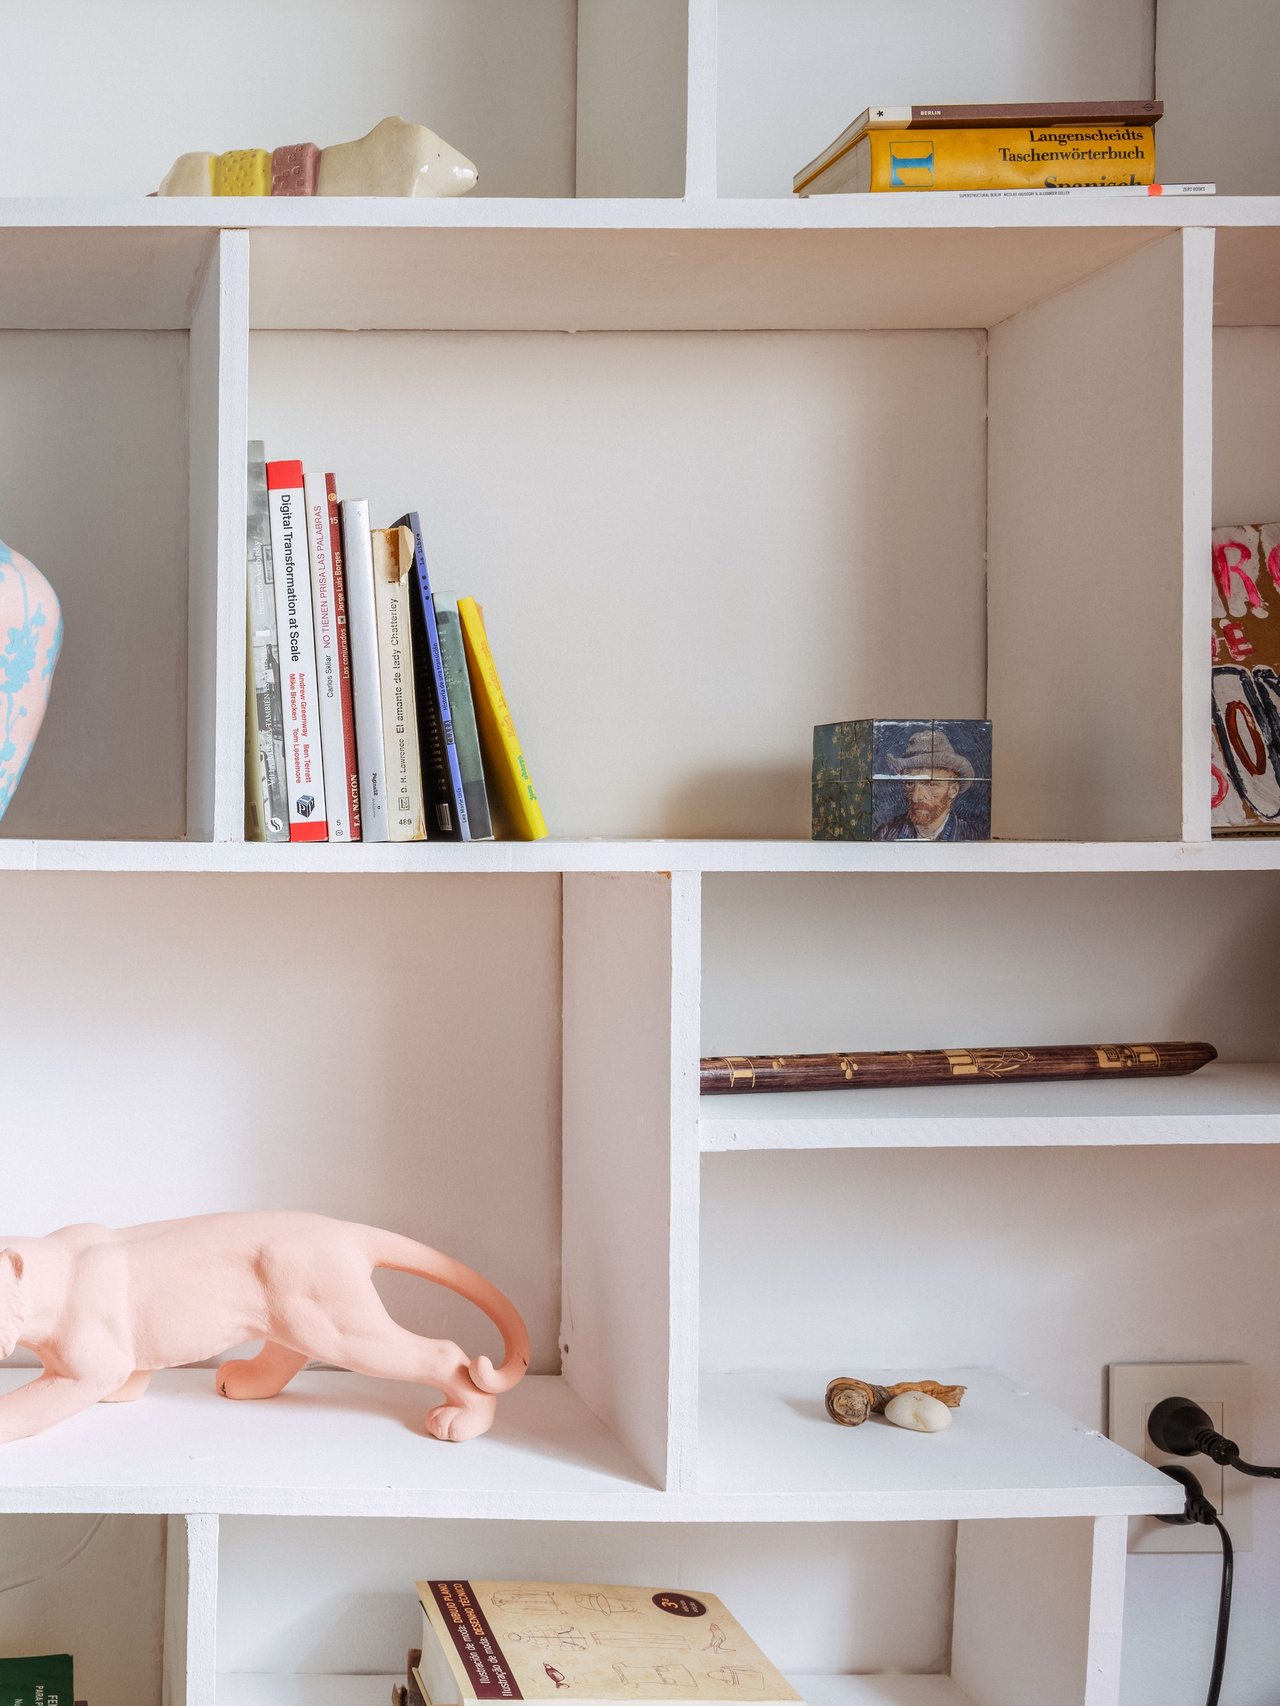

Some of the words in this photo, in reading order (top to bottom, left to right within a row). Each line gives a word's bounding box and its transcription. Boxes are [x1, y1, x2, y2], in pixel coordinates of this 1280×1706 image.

[1029, 130, 1144, 146] Langenscheidts
[998, 147, 1145, 163] Taschenwörterbuch
[280, 494, 292, 529] Digital
[314, 505, 324, 552] PALABRAS
[253, 539, 263, 575] Verbitsky
[318, 553, 326, 571] LAS
[334, 552, 342, 576] Borges
[420, 557, 425, 566] La
[283, 532, 297, 616] Transformation
[319, 571, 327, 599] PRISA
[255, 576, 264, 615] Bernardo
[337, 591, 345, 612] Jorge
[289, 618, 297, 629] at
[320, 600, 330, 632] TIENEN
[389, 598, 399, 646] Chatterley
[289, 631, 299, 662] Scale
[323, 634, 331, 649] NO
[339, 628, 349, 665] conjurados
[392, 649, 402, 670] lady
[433, 643, 444, 670] transición
[298, 673, 307, 700] Andrew
[326, 676, 334, 698] Carlos
[394, 672, 401, 684] de
[439, 681, 446, 689] de
[394, 686, 404, 721] amante
[440, 689, 448, 711] Historia
[300, 701, 308, 737] Greenway
[396, 725, 404, 734] El
[293, 742, 301, 784] Loosemore
[398, 738, 407, 773] Lawrence
[353, 813, 361, 827] LA
[437, 1583, 452, 1602] PLANO
[453, 1583, 471, 1607] TÉCNICO
[446, 1602, 463, 1624] DIBUJO
[464, 1608, 485, 1636] DESENHO
[457, 1624, 472, 1642] moda:
[465, 1643, 476, 1651] de
[479, 1636, 494, 1655] moda:
[469, 1651, 491, 1684] Ilustración
[487, 1655, 498, 1664] de
[492, 1664, 513, 1697] Ilustração
[35, 1685, 44, 1701] PARA
